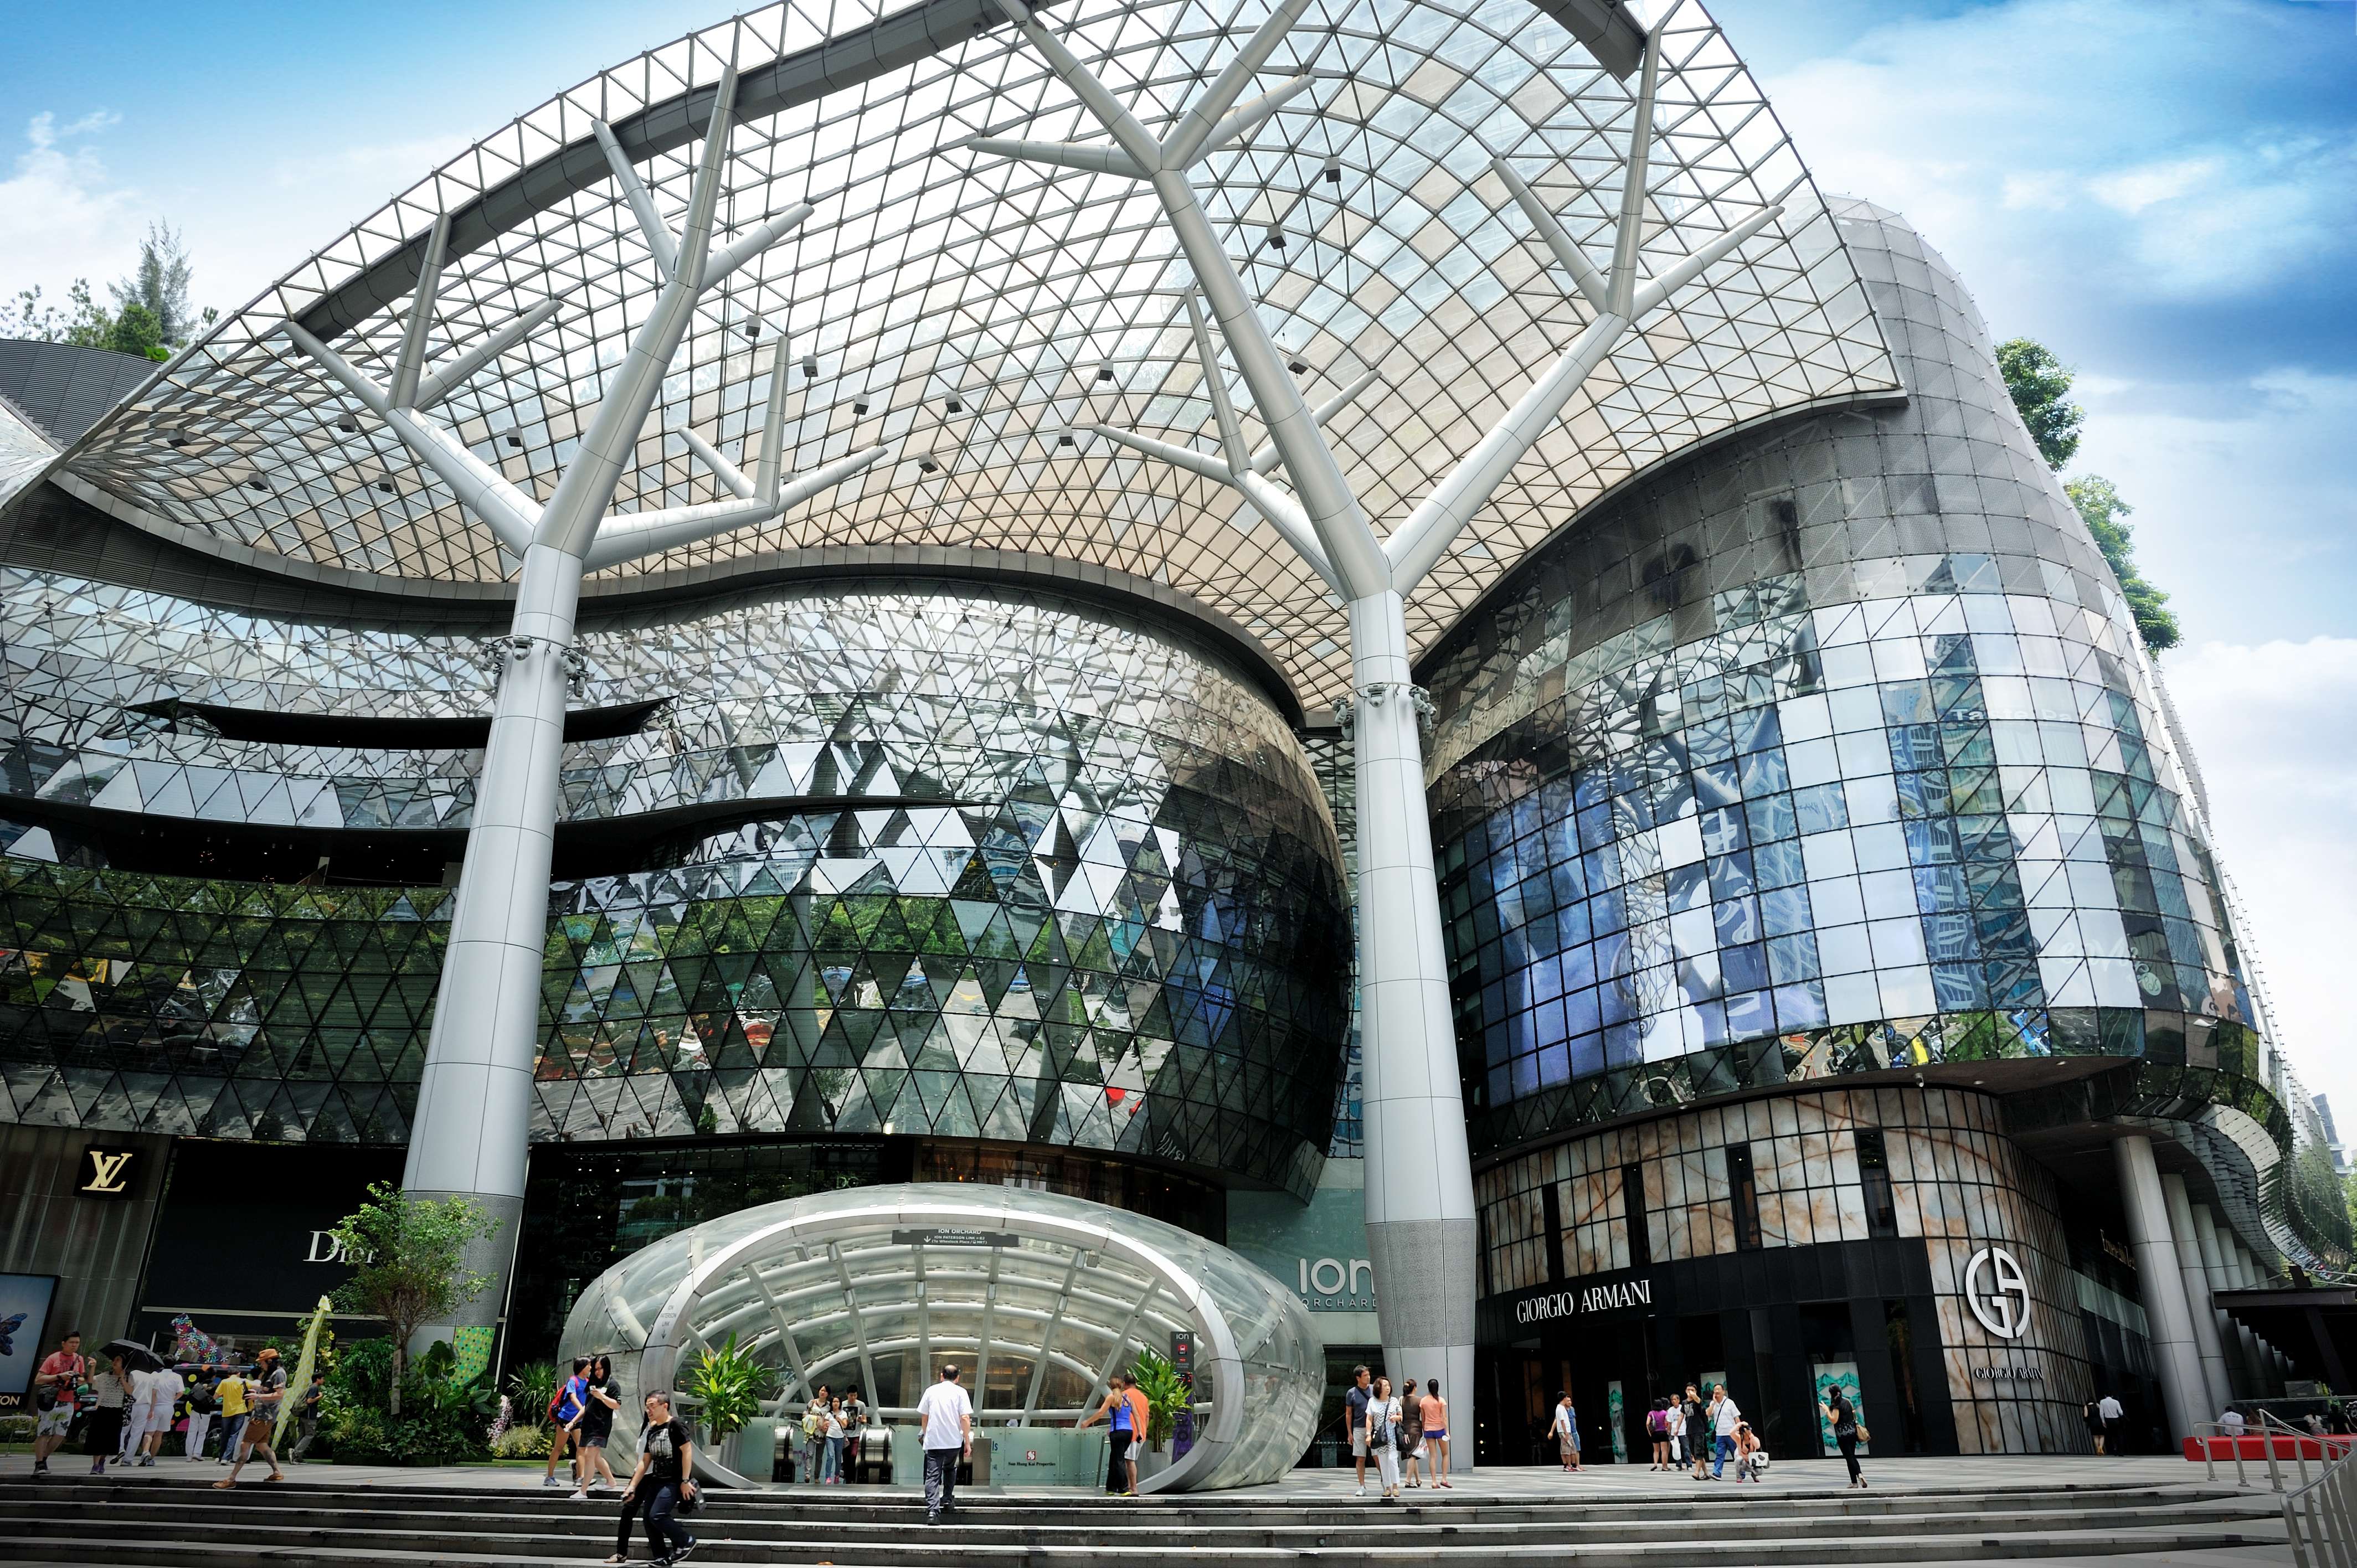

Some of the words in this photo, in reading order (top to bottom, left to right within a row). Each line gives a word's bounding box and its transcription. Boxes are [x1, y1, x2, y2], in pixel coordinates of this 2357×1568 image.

[81, 1151, 133, 1192] LV
[1517, 1292, 1574, 1323] GIORGIO
[1581, 1280, 1652, 1313] ARMANI
[1975, 1368, 2016, 1379] GIORGIO
